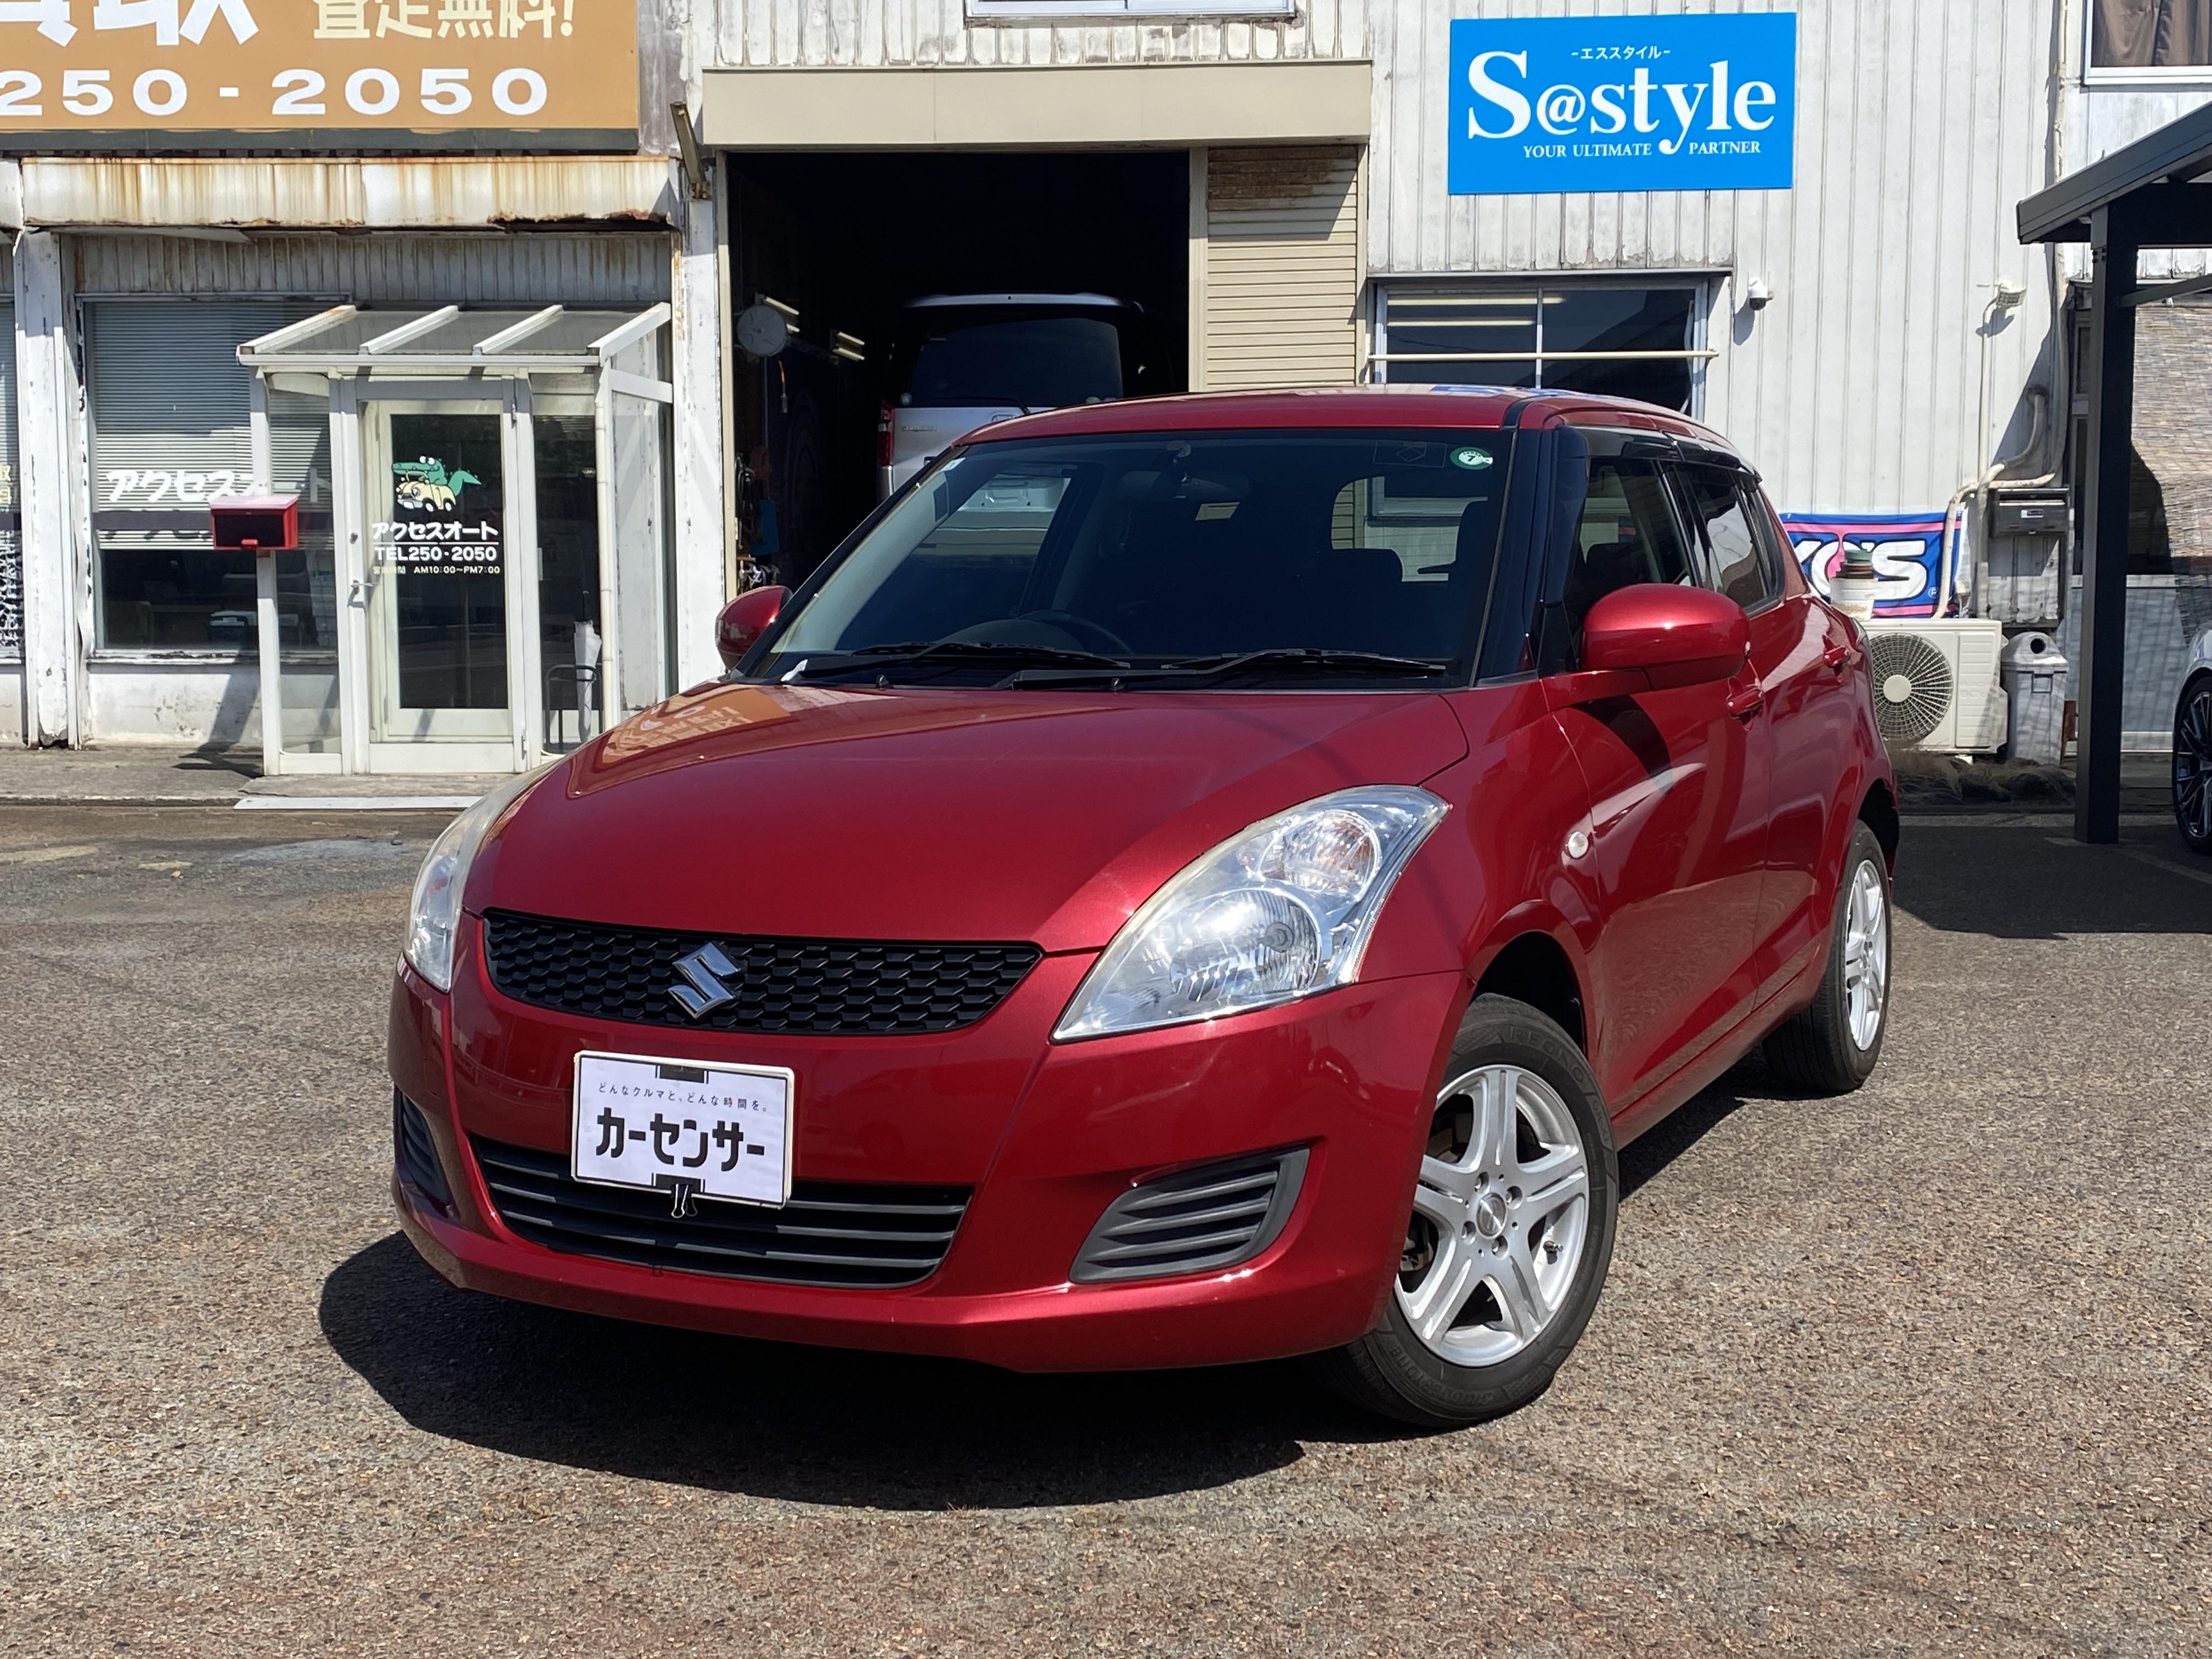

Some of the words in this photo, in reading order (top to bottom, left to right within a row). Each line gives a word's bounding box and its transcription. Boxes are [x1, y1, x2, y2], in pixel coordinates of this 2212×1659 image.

[1468, 50, 1776, 155] S@style
[1523, 145, 1567, 158] YOUR
[1573, 143, 1652, 157] ULTIMATE
[1689, 140, 1761, 155] PARTNER
[371, 521, 499, 541] アクセスオート
[596, 1107, 765, 1172] カーセンサー
